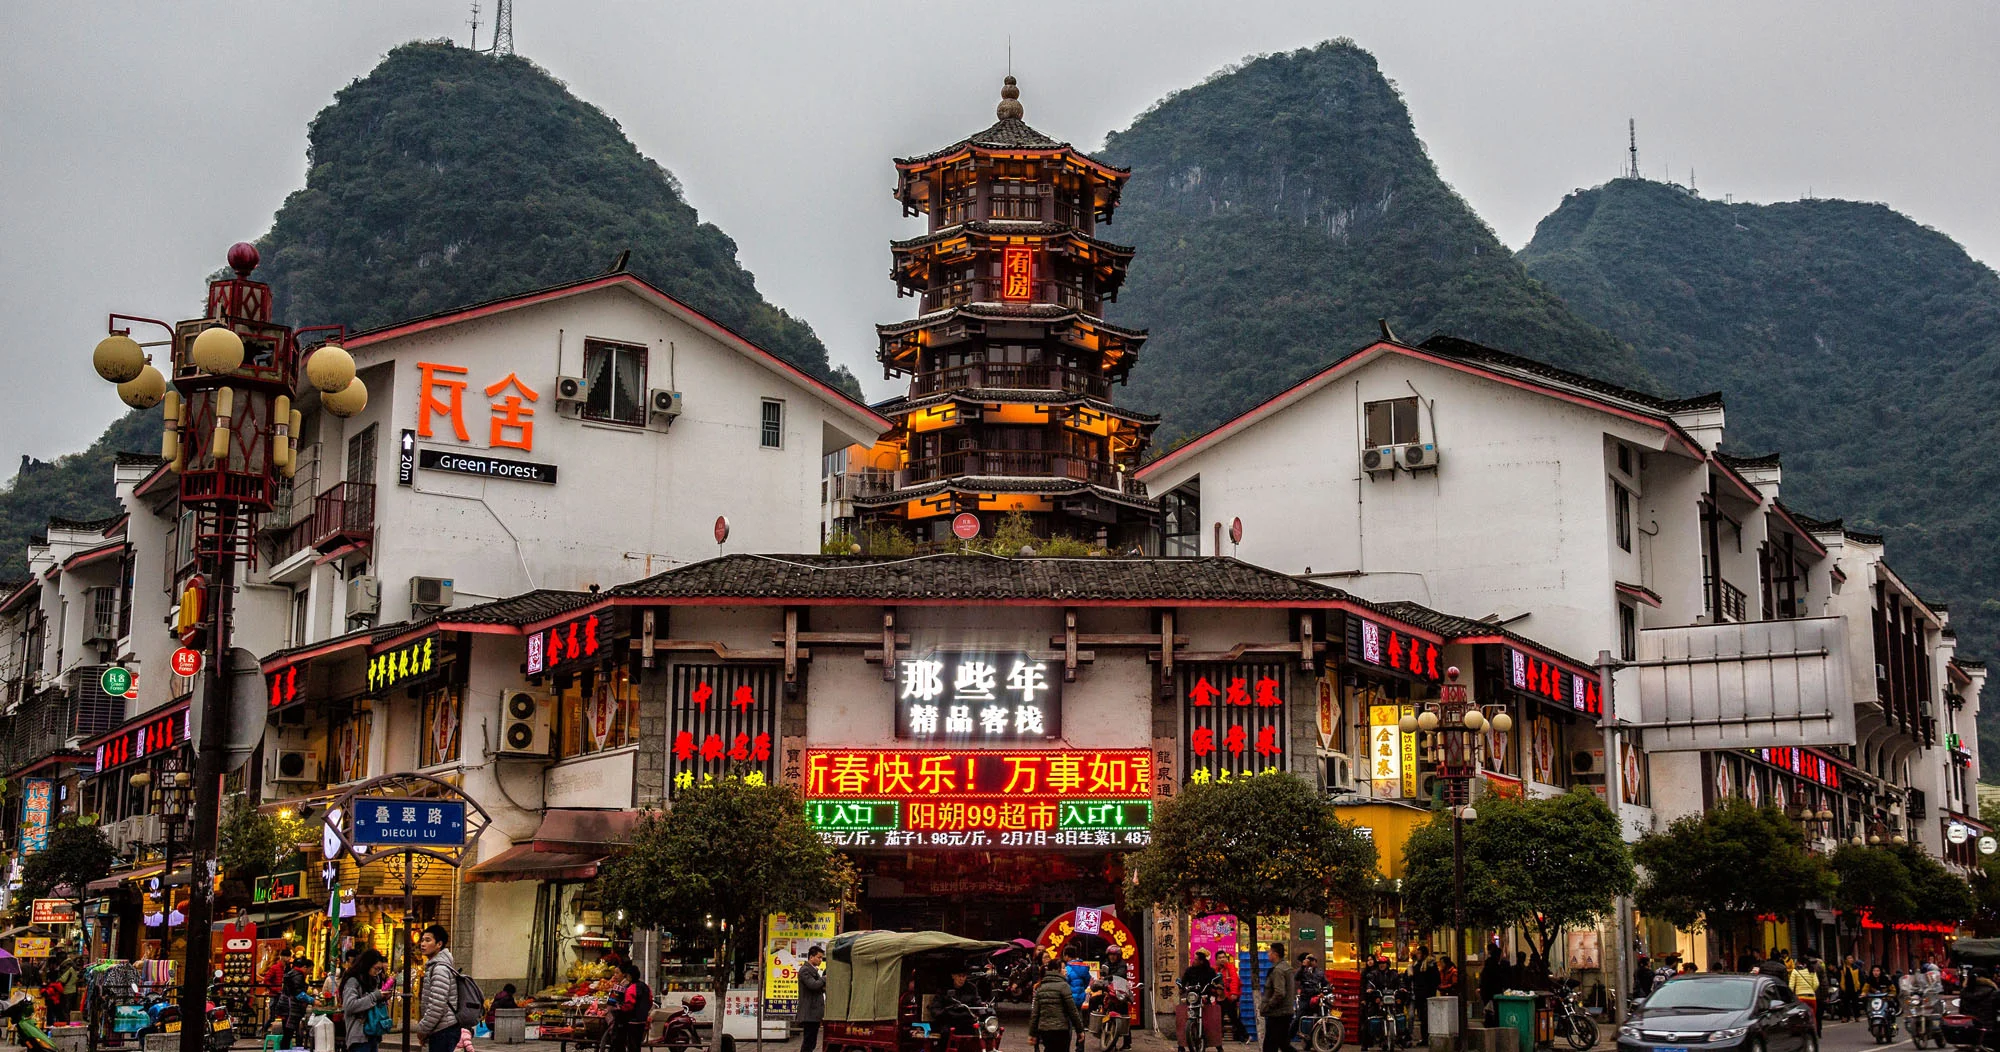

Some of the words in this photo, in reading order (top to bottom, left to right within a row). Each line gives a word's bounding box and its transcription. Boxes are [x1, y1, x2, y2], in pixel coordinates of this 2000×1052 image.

[1008, 252, 1028, 296] 有房
[417, 361, 539, 452] 瓦舍
[401, 454, 413, 481] 20m
[440, 455, 486, 473] Green
[490, 461, 538, 479] Forest
[179, 653, 194, 662] 瓦舍
[368, 637, 432, 692] 中华餐饮名店
[110, 674, 125, 682] 瓦舍
[901, 660, 1049, 701] 那些年
[1189, 676, 1282, 708] 金龙寨
[692, 681, 755, 714] 中华
[910, 704, 1044, 733] 精品客栈
[672, 731, 771, 761] 餐饮名店
[1192, 725, 1282, 759] 家常菜
[1376, 728, 1393, 776] 金龍寨
[375, 806, 442, 825] 叠翠路
[831, 804, 872, 824] 入口
[909, 802, 1056, 830] 阳朔99超市
[1064, 804, 1114, 824] 入口
[382, 829, 417, 837] DIECUI
[774, 957, 781, 965] 6
